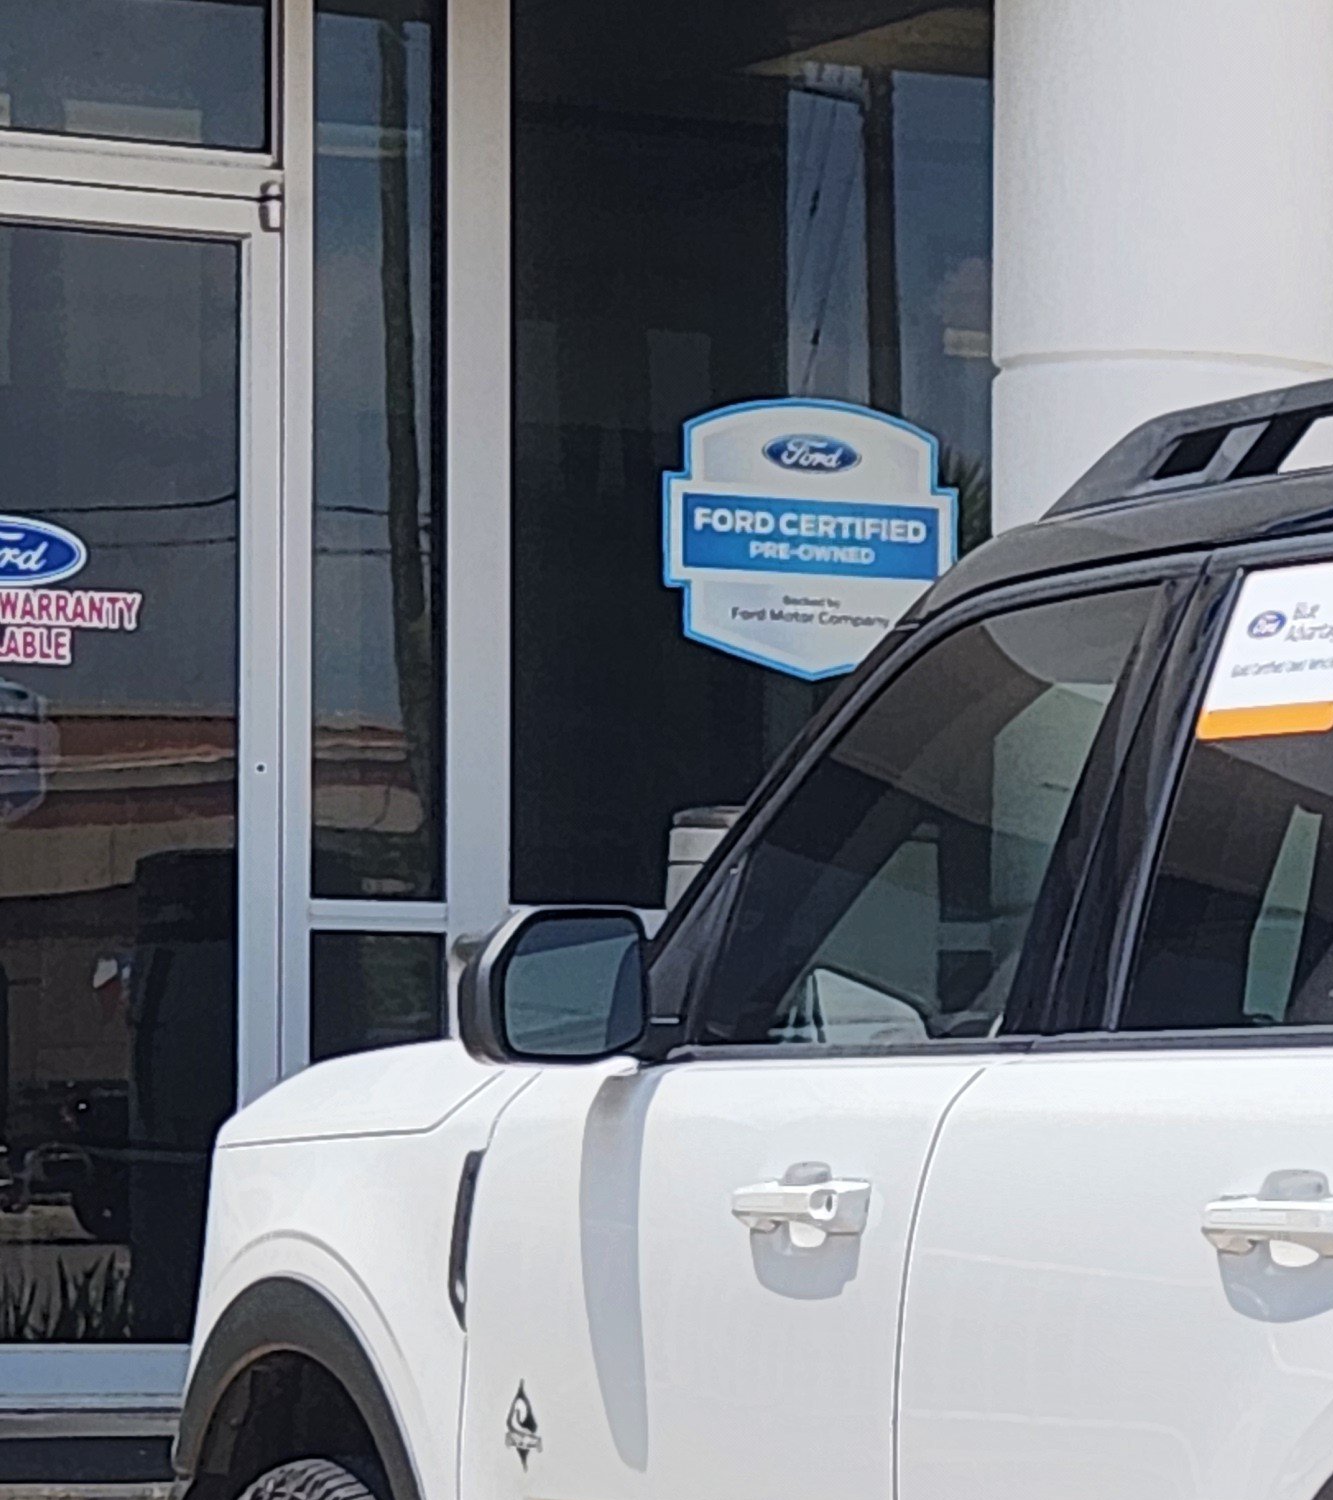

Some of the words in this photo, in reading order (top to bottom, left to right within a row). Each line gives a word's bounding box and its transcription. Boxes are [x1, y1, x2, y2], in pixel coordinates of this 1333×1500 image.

[781, 437, 840, 468] Ford
[693, 507, 775, 535] FORD
[779, 512, 927, 543] CERTIFIED
[749, 541, 876, 565] PRE-OWNED
[0, 591, 140, 626] WARRANTY
[731, 606, 767, 621] Ford
[769, 608, 814, 623] Motor
[818, 611, 890, 628] Company
